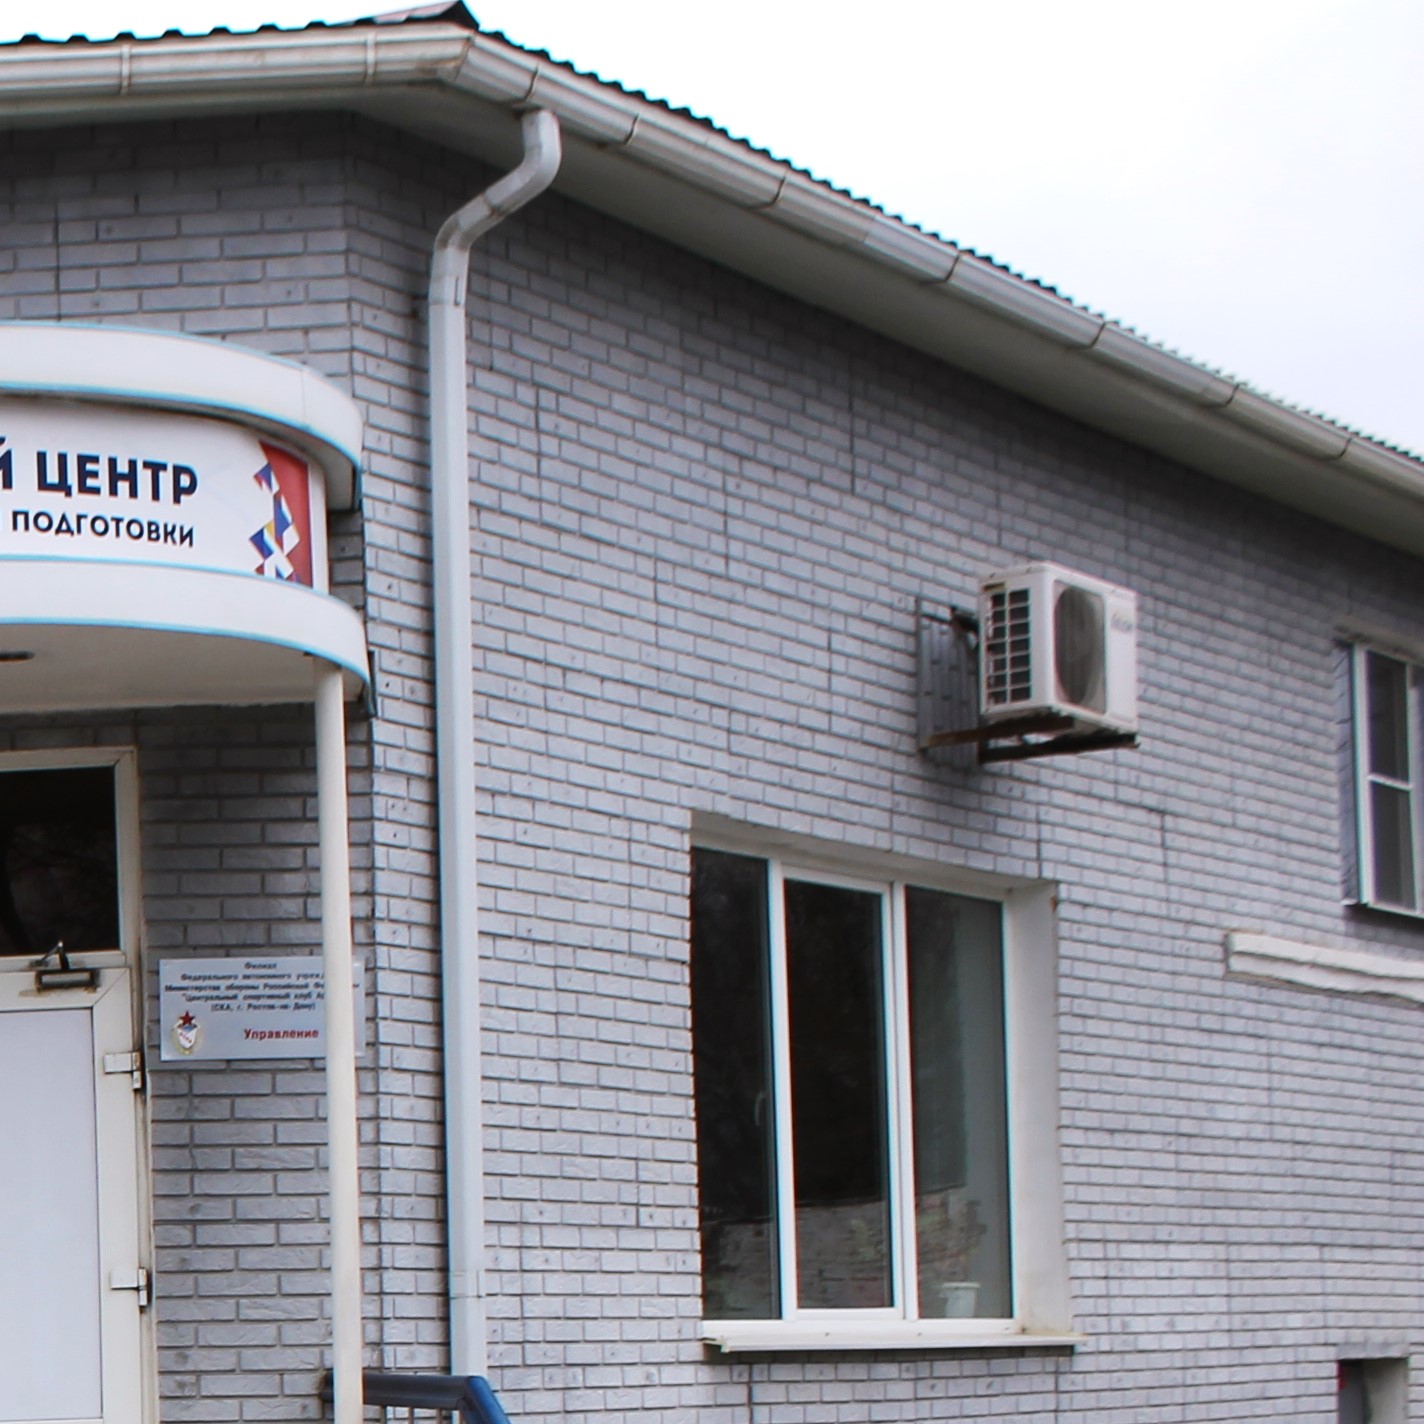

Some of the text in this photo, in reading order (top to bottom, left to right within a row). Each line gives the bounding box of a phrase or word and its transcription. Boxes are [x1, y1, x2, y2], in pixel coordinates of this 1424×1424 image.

[35, 450, 198, 505] ЦЕНТР
[11, 509, 194, 548] ПОДГОТОВКИ
[244, 1028, 319, 1041] Управление
